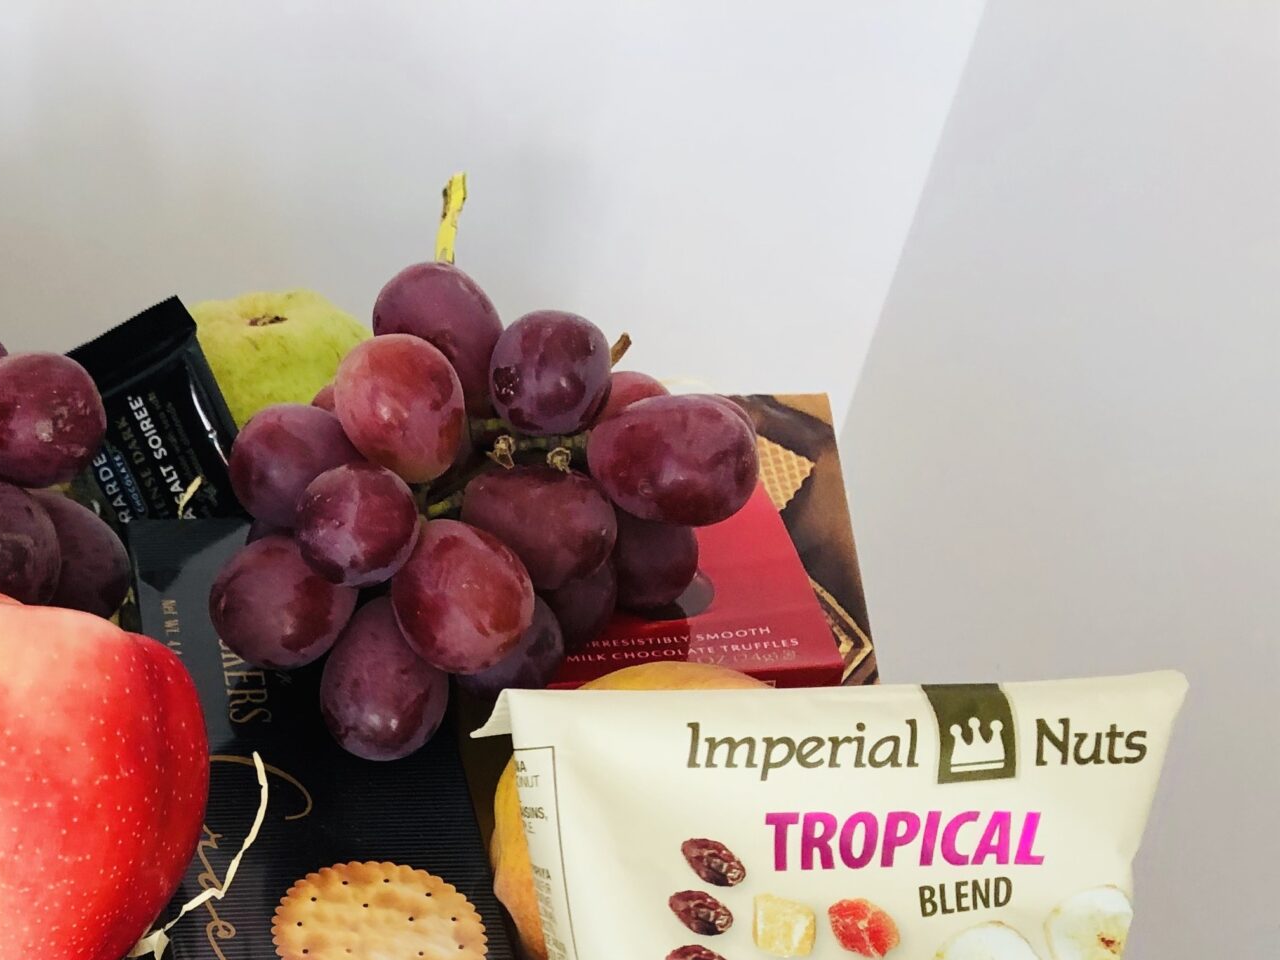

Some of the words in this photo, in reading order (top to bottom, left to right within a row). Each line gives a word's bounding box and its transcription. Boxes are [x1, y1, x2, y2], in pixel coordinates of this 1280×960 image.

[566, 653, 607, 664] MILK
[612, 646, 715, 661] CHOCOLATE
[720, 638, 800, 653] TRUFFLES
[696, 626, 771, 642] SMOOTH
[685, 719, 920, 782] Imperial
[1034, 717, 1148, 767] Nuts
[764, 811, 1046, 872] TROPICAL
[918, 876, 1014, 918] BLEND
